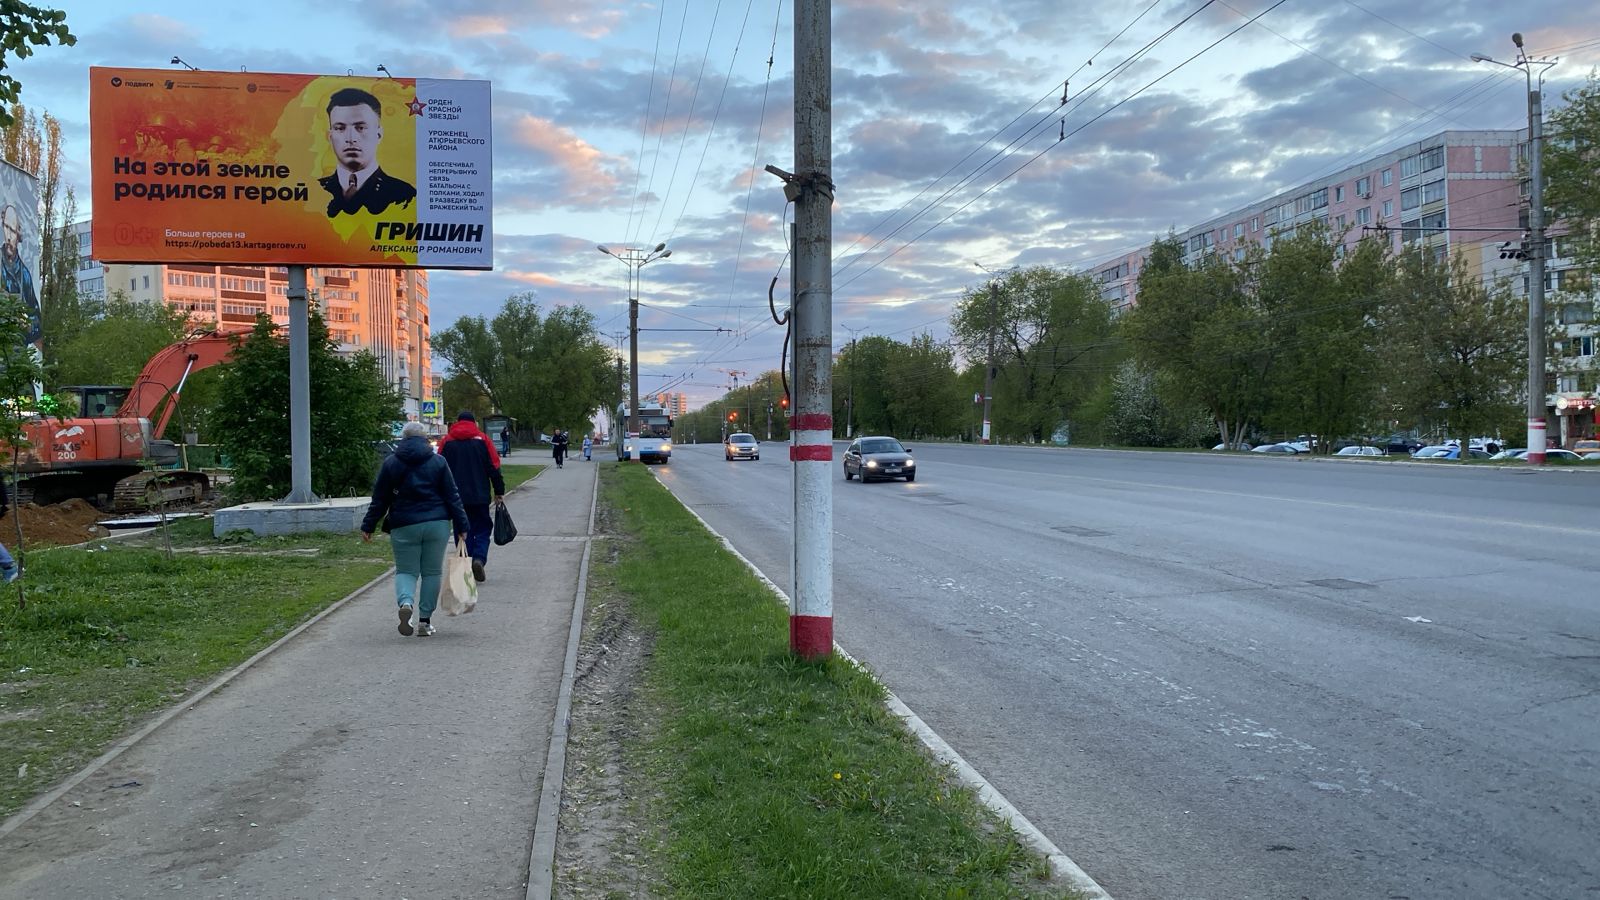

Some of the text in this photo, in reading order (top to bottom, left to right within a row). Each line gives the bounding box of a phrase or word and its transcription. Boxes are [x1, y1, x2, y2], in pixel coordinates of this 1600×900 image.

[428, 105, 462, 113] КРАСНОЙ
[428, 130, 468, 138] УРОЖЕНЕЦ
[428, 137, 485, 145] АТЮРЬЕВСКОГО
[114, 157, 290, 178] На этой земле
[114, 182, 309, 204] родился герой
[165, 229, 200, 238] Больше
[202, 231, 233, 240] героев
[374, 222, 484, 242] ГРИШИН
[165, 239, 307, 250] https://pobeda13.kartageroev.ru
[369, 244, 483, 254] АЛЕКСАНДР РОМАНОВИЧ
[57, 451, 77, 460] 200
